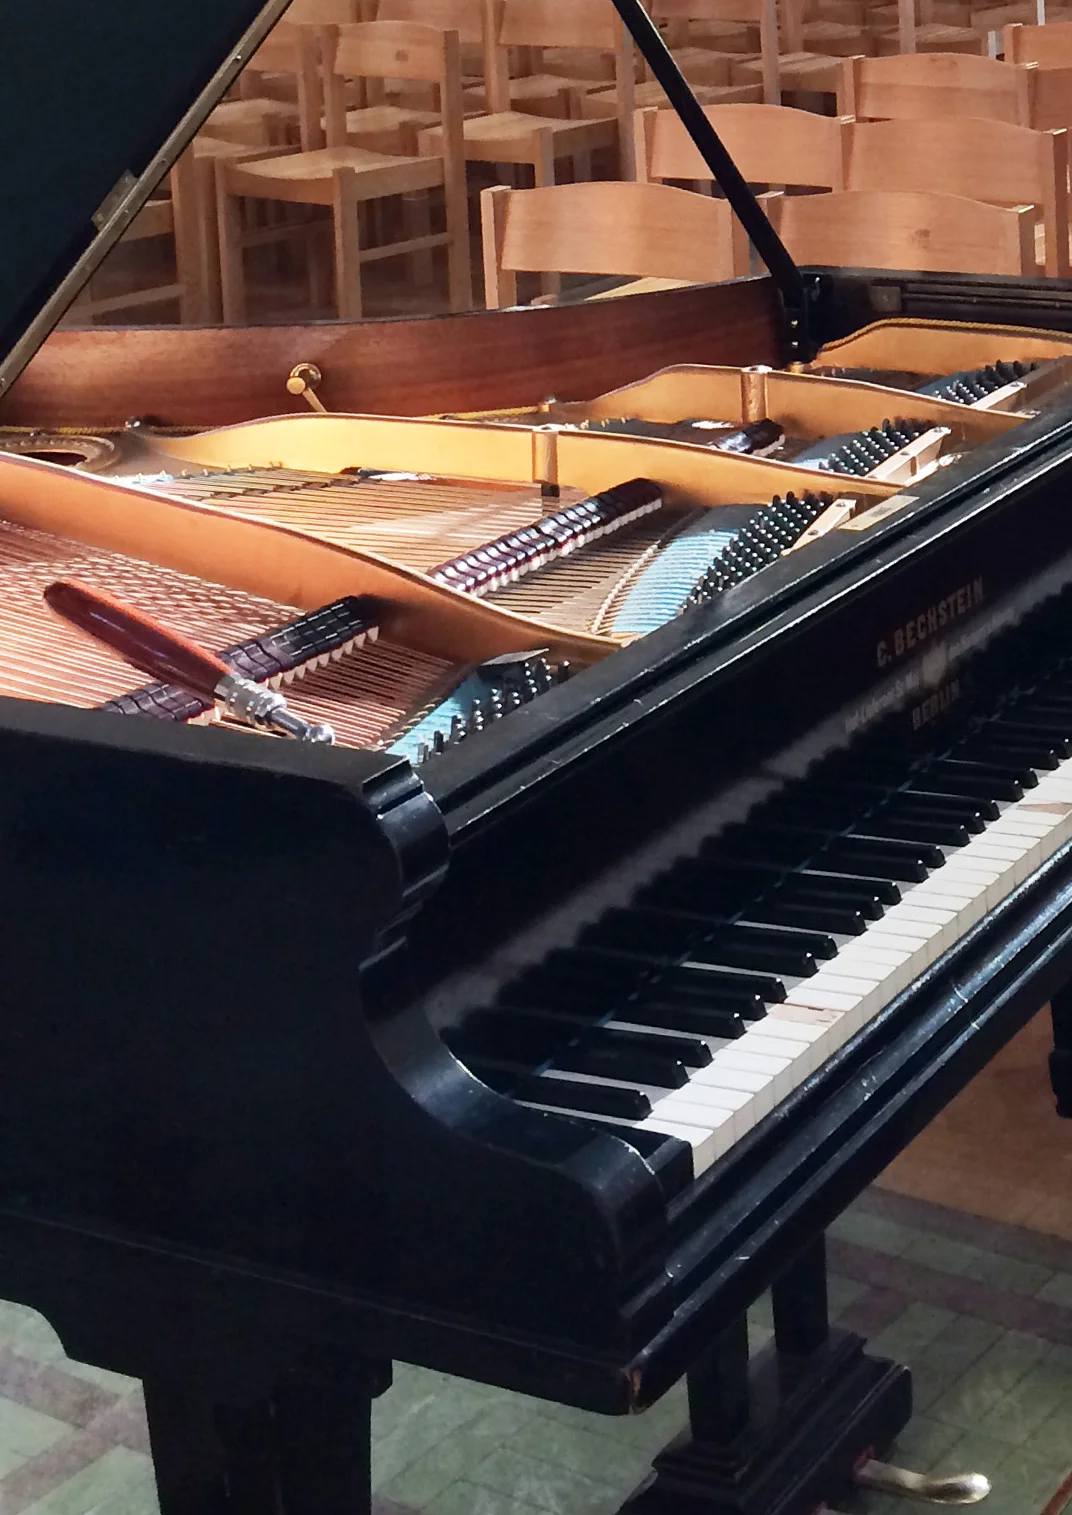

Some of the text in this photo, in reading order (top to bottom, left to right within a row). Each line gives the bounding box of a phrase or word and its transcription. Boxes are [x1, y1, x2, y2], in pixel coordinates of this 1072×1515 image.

[876, 640, 892, 668] C.
[894, 575, 985, 656] BECHSTEIN
[911, 680, 961, 731] BERLIN
